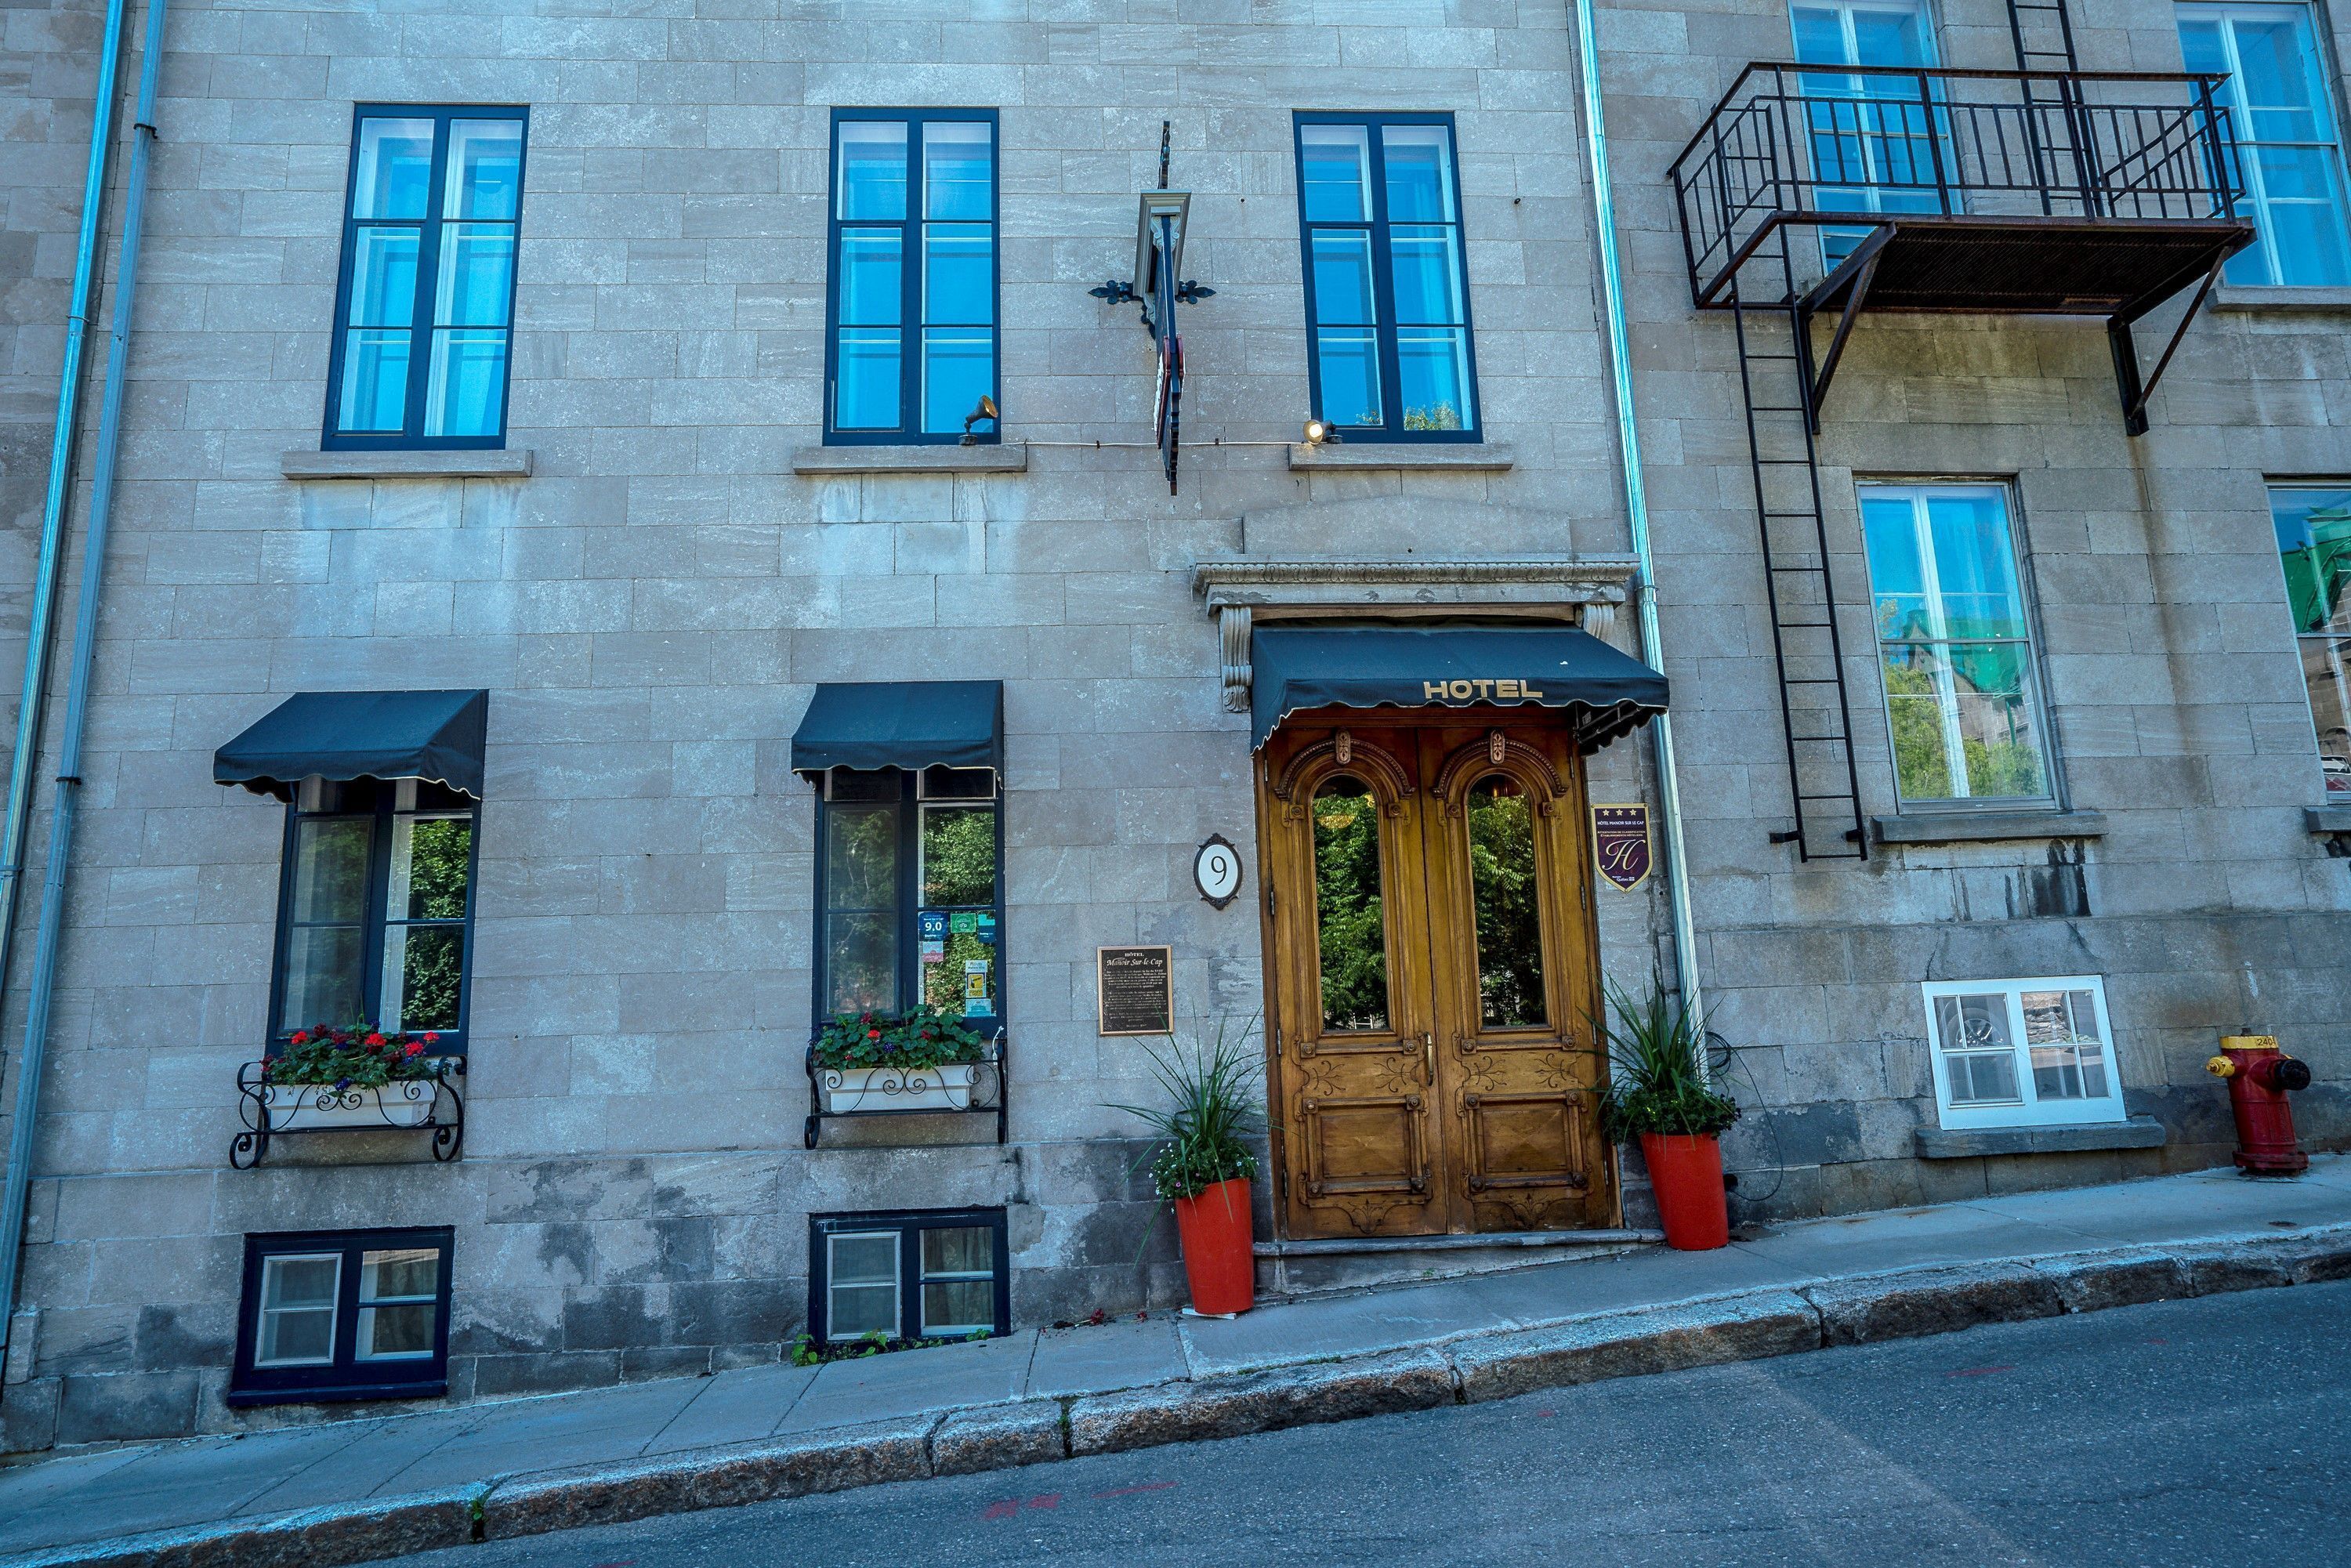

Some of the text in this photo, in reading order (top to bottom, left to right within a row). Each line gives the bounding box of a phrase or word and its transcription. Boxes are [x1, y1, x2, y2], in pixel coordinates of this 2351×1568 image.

[1423, 679, 1543, 699] HOTEL
[1211, 856, 1227, 885] 9
[925, 922, 943, 932] 9.0
[1107, 958, 1131, 966] Manoir
